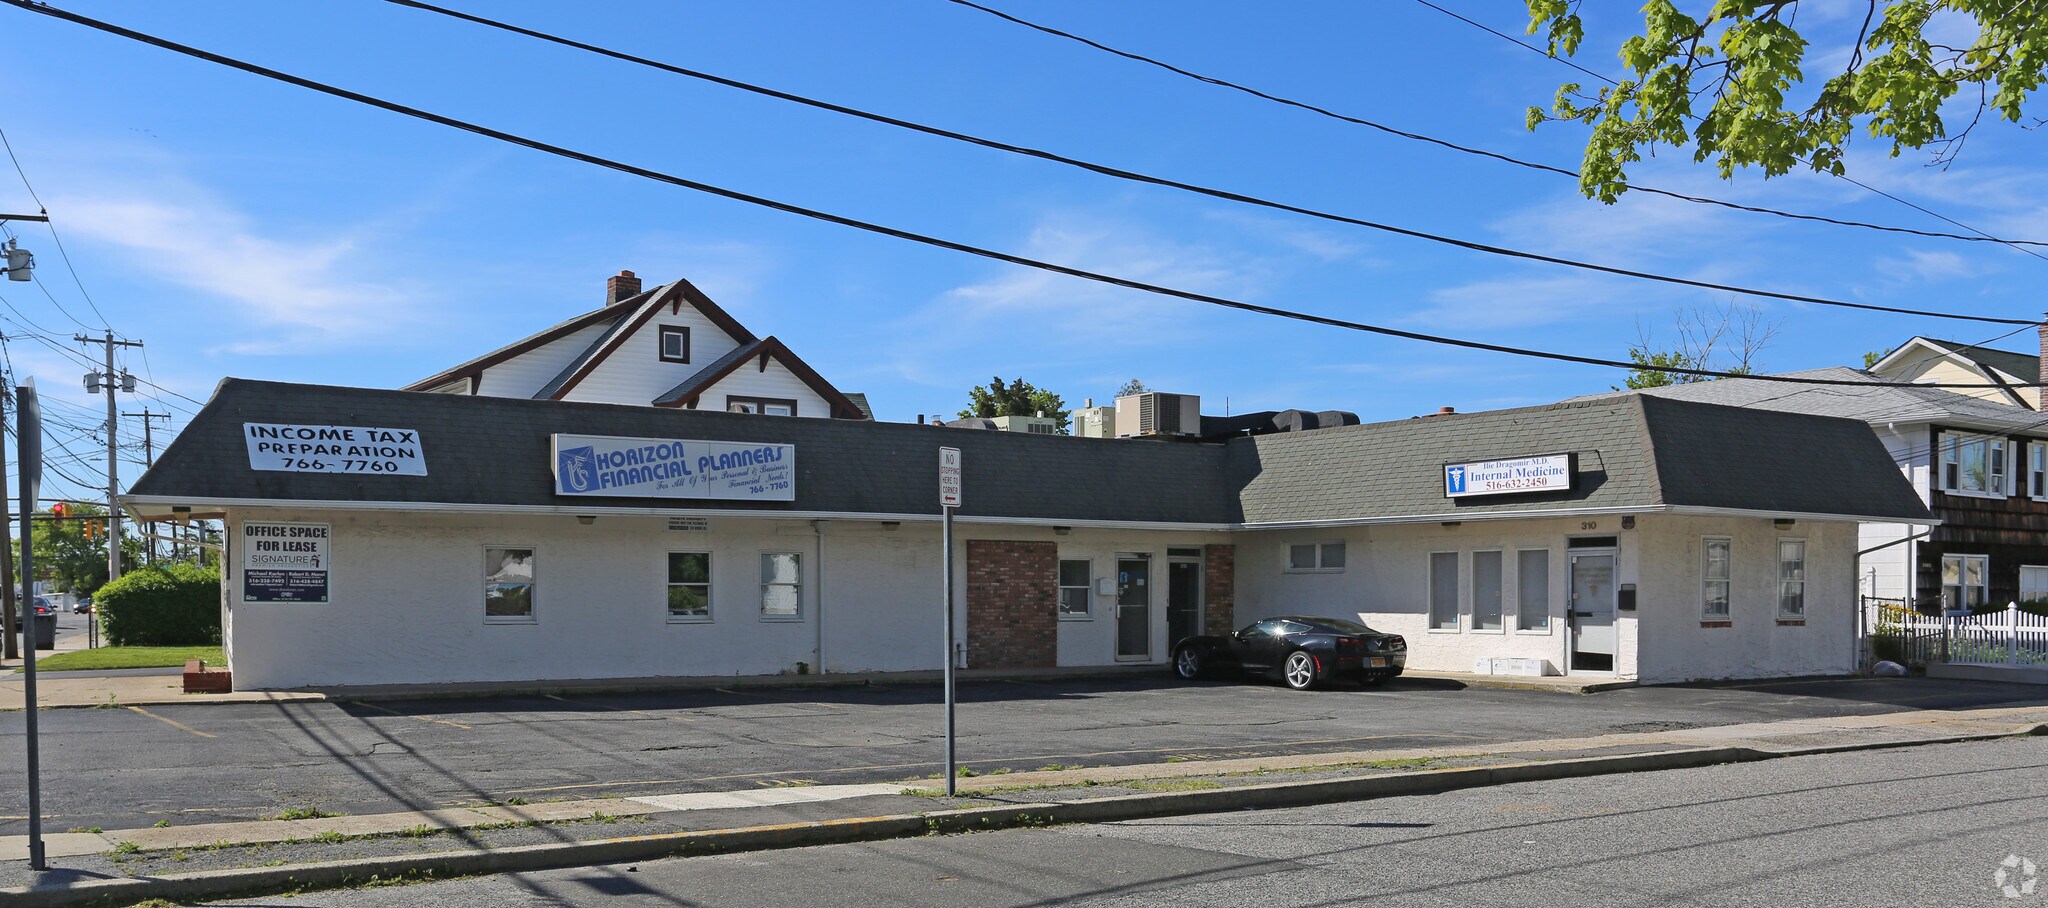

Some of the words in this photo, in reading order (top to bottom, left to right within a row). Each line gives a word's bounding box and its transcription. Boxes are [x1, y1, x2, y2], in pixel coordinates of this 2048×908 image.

[250, 425, 356, 441] INCOME
[366, 430, 416, 444] TAX
[258, 442, 416, 458] PREPARATION
[596, 441, 685, 470] HORIZON
[945, 454, 954, 464] NO
[1496, 460, 1529, 469] Dragomir
[600, 460, 692, 490] FINANCIAL
[698, 446, 784, 474] PLANNERS
[1470, 469, 1512, 481] Internal
[1516, 465, 1565, 478] Medicine
[656, 481, 669, 490] For
[672, 478, 685, 488] All
[721, 467, 749, 480] Personal
[760, 464, 788, 473] Business
[728, 478, 760, 488] Financial
[1486, 477, 1547, 490] 516-632-2450
[942, 486, 958, 494] CORNER
[1581, 521, 1597, 530] 310
[246, 526, 287, 537] OFFICE
[289, 527, 327, 538] SPACE
[256, 541, 279, 551] FOR
[283, 541, 317, 552] LEASE
[252, 555, 308, 563] SIGNATURE
